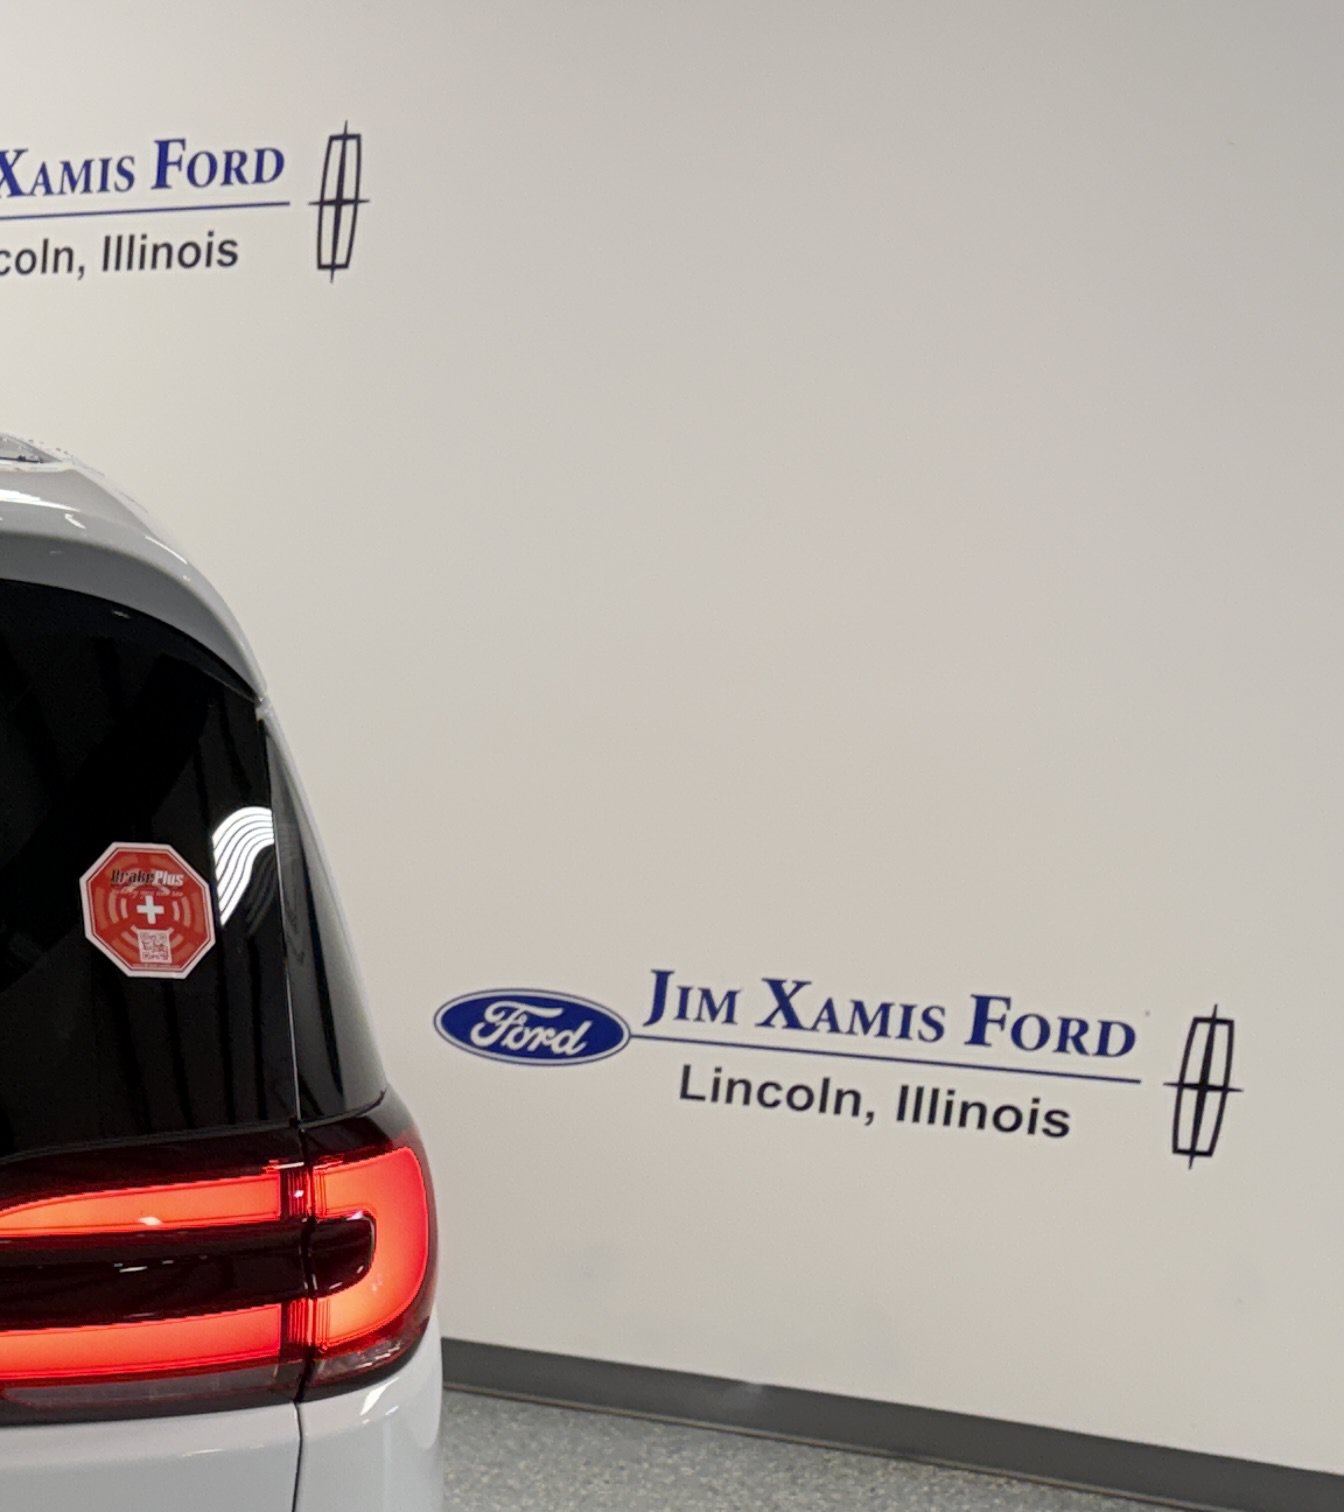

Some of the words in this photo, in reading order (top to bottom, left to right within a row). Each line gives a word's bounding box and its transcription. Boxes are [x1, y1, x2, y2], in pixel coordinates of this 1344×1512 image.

[150, 138, 285, 189] FORD
[101, 230, 239, 273] Illinois
[470, 1001, 591, 1057] Ford
[642, 969, 742, 1027] JIM
[756, 977, 946, 1043] XAMIS
[964, 993, 1138, 1059] FORD
[679, 1063, 878, 1126] Lincoln,
[895, 1085, 1071, 1138] Illinois
